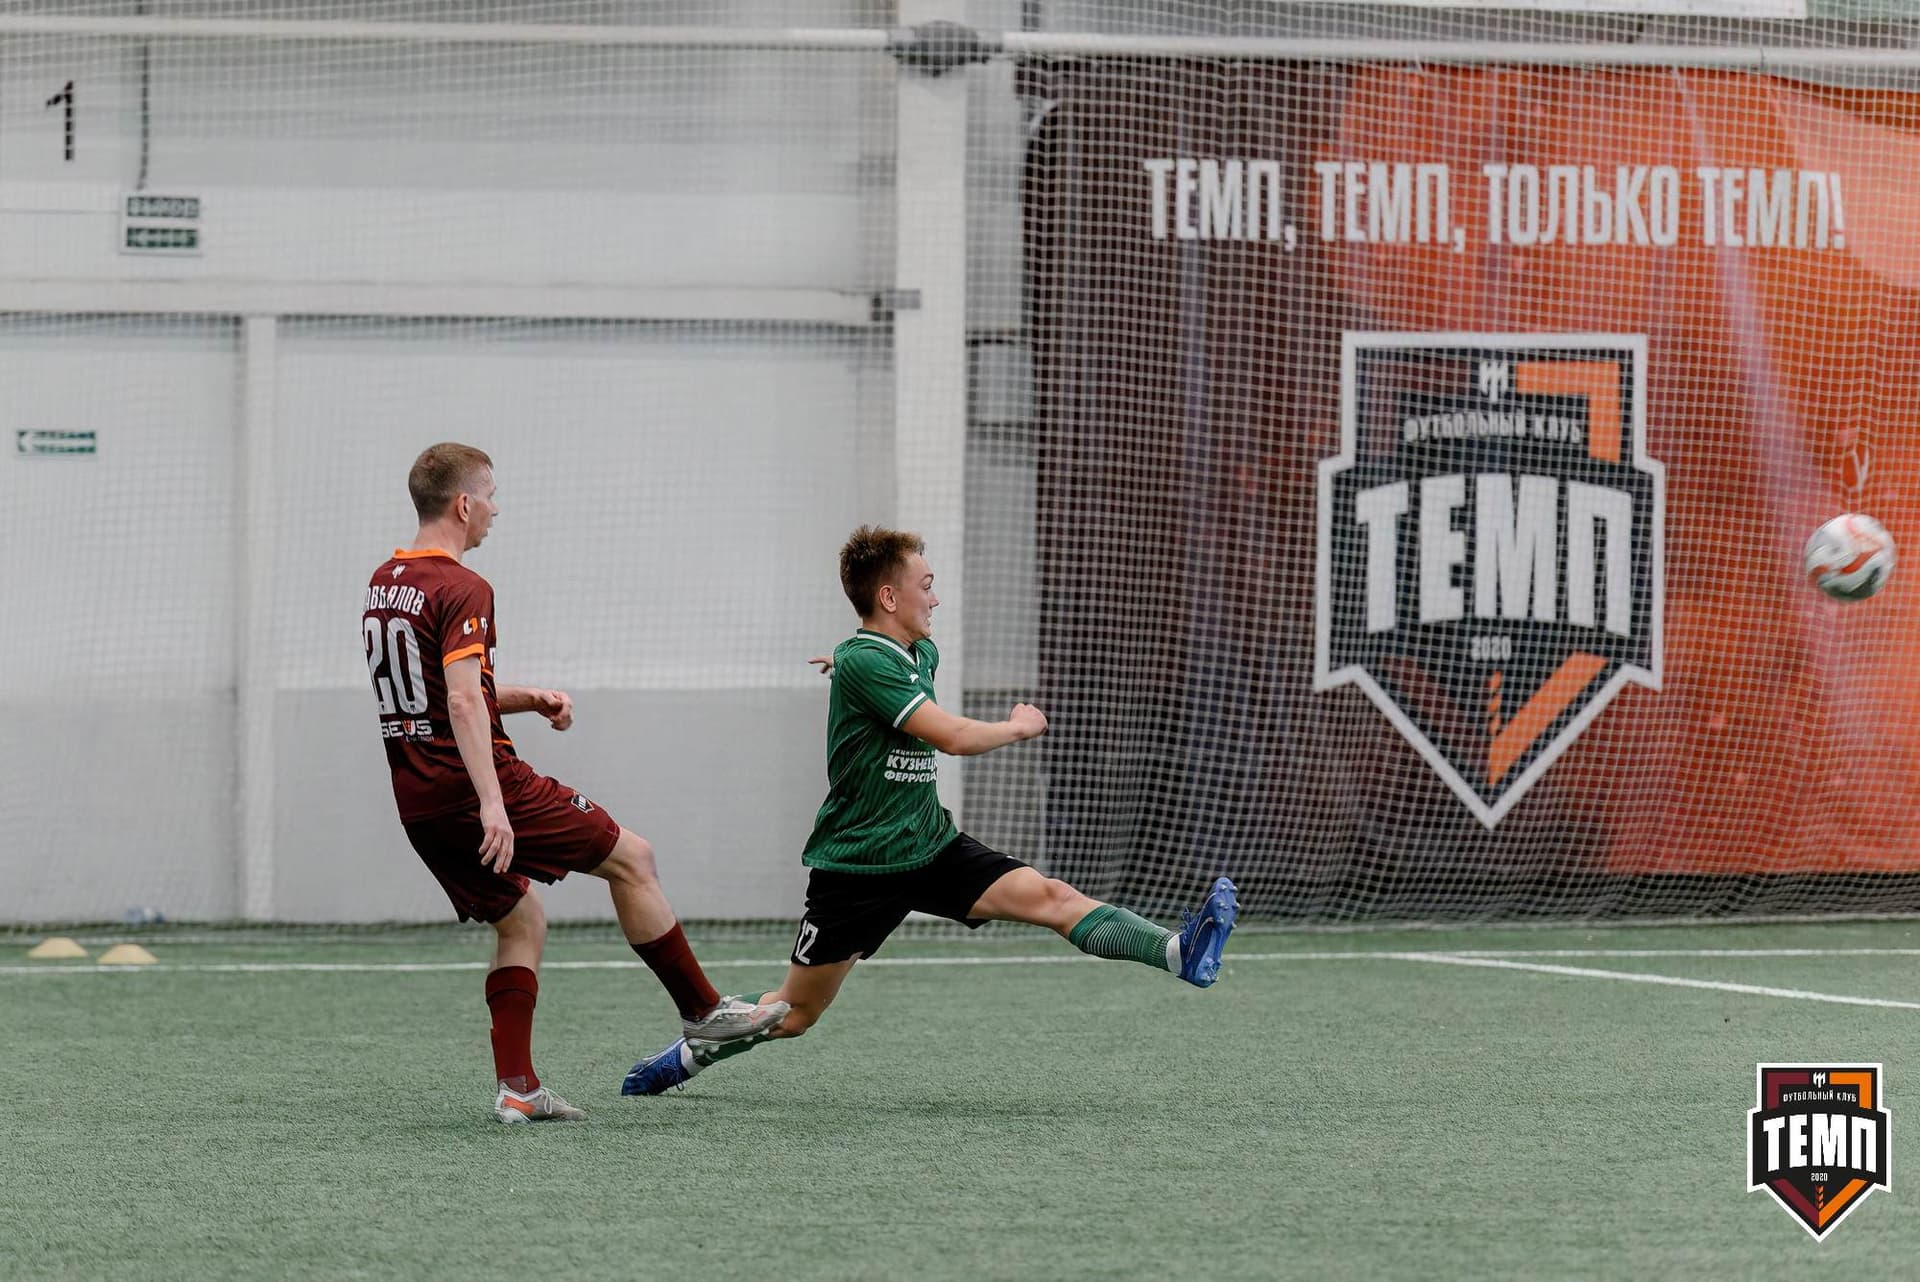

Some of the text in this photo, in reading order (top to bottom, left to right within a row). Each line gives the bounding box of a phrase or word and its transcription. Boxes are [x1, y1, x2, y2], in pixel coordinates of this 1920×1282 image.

[45, 81, 74, 161] 1
[1144, 158, 1846, 252] ТЕМП, ТЕМП, ТОЛЬКО ТЕМП!
[1403, 409, 1581, 444] ФУТБОЛЬНЫЙ КЛУБ
[1355, 472, 1632, 637] ТЕМП
[366, 584, 425, 616] ВЬЯЛОВ
[363, 616, 428, 714] 20
[1470, 635, 1513, 662] 2020
